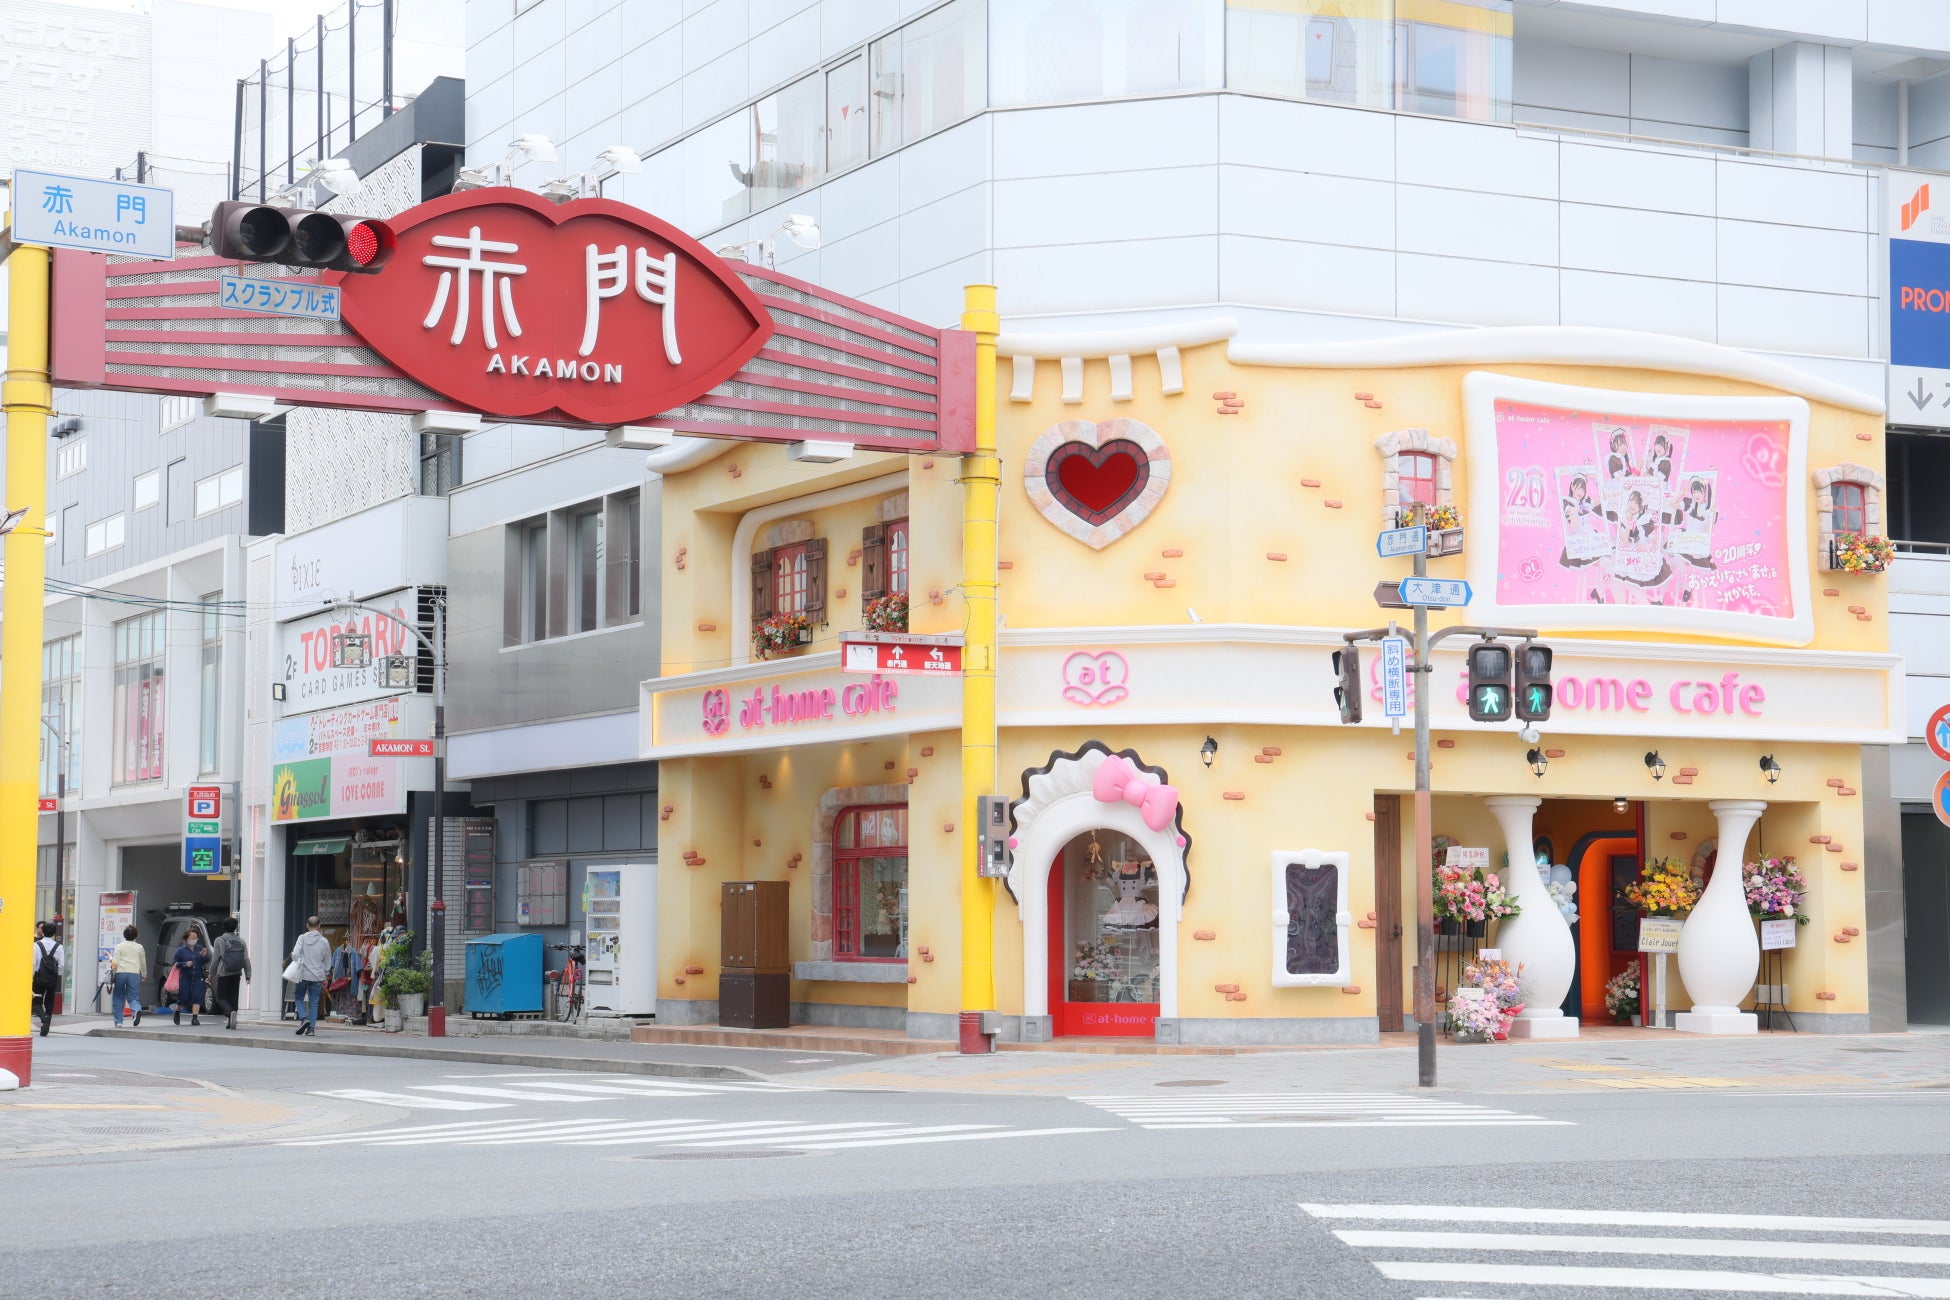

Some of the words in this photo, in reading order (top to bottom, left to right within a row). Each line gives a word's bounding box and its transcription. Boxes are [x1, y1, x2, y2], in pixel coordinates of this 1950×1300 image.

[42, 185, 147, 226] 赤門
[53, 220, 136, 245] Akamon
[226, 281, 337, 316] スクランブル式
[421, 226, 682, 367] 赤門
[486, 353, 624, 385] AKAMON
[1507, 468, 1545, 508] 20
[1412, 582, 1460, 596] 大津通
[1422, 594, 1451, 603] Otsu-dori
[285, 654, 298, 681] 2F
[1079, 660, 1111, 685] at
[1386, 644, 1401, 712] 斜め横断専用
[301, 678, 326, 699] CARD
[332, 669, 367, 690] GAMES
[1669, 671, 1766, 716] cafe
[739, 684, 836, 728] at-home
[842, 674, 898, 717] cafe
[375, 743, 413, 753] AKAMON
[197, 802, 211, 813] P
[192, 848, 213, 870] 空
[1641, 937, 1659, 947] Clair
